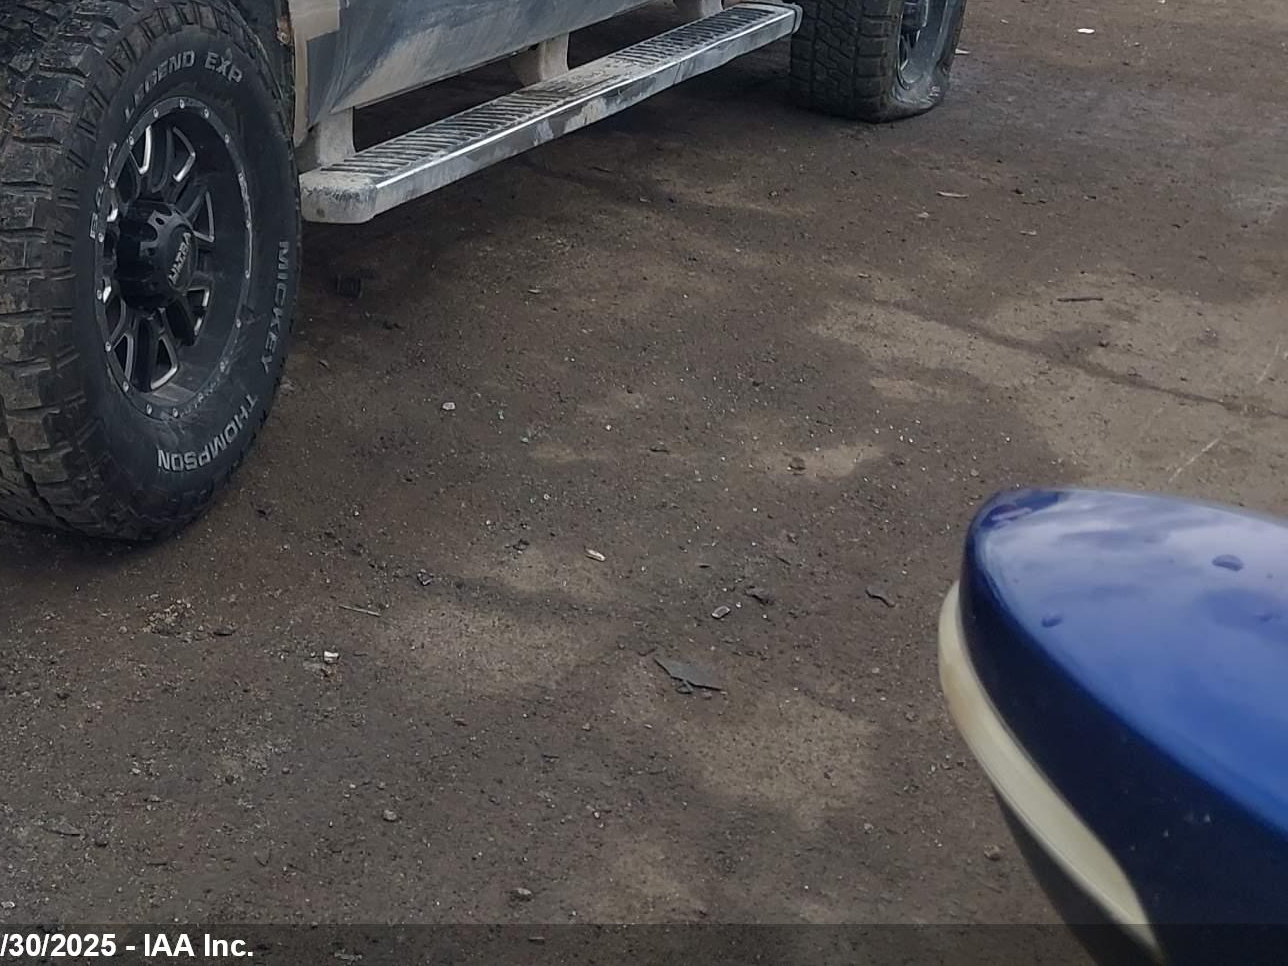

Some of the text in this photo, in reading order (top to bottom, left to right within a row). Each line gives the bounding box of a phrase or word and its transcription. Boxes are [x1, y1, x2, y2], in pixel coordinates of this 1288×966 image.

[124, 49, 243, 123] LEGEND EXP
[168, 232, 192, 285] ULTRA
[261, 241, 290, 375] MICKEY
[157, 393, 259, 472] THOMPSON
